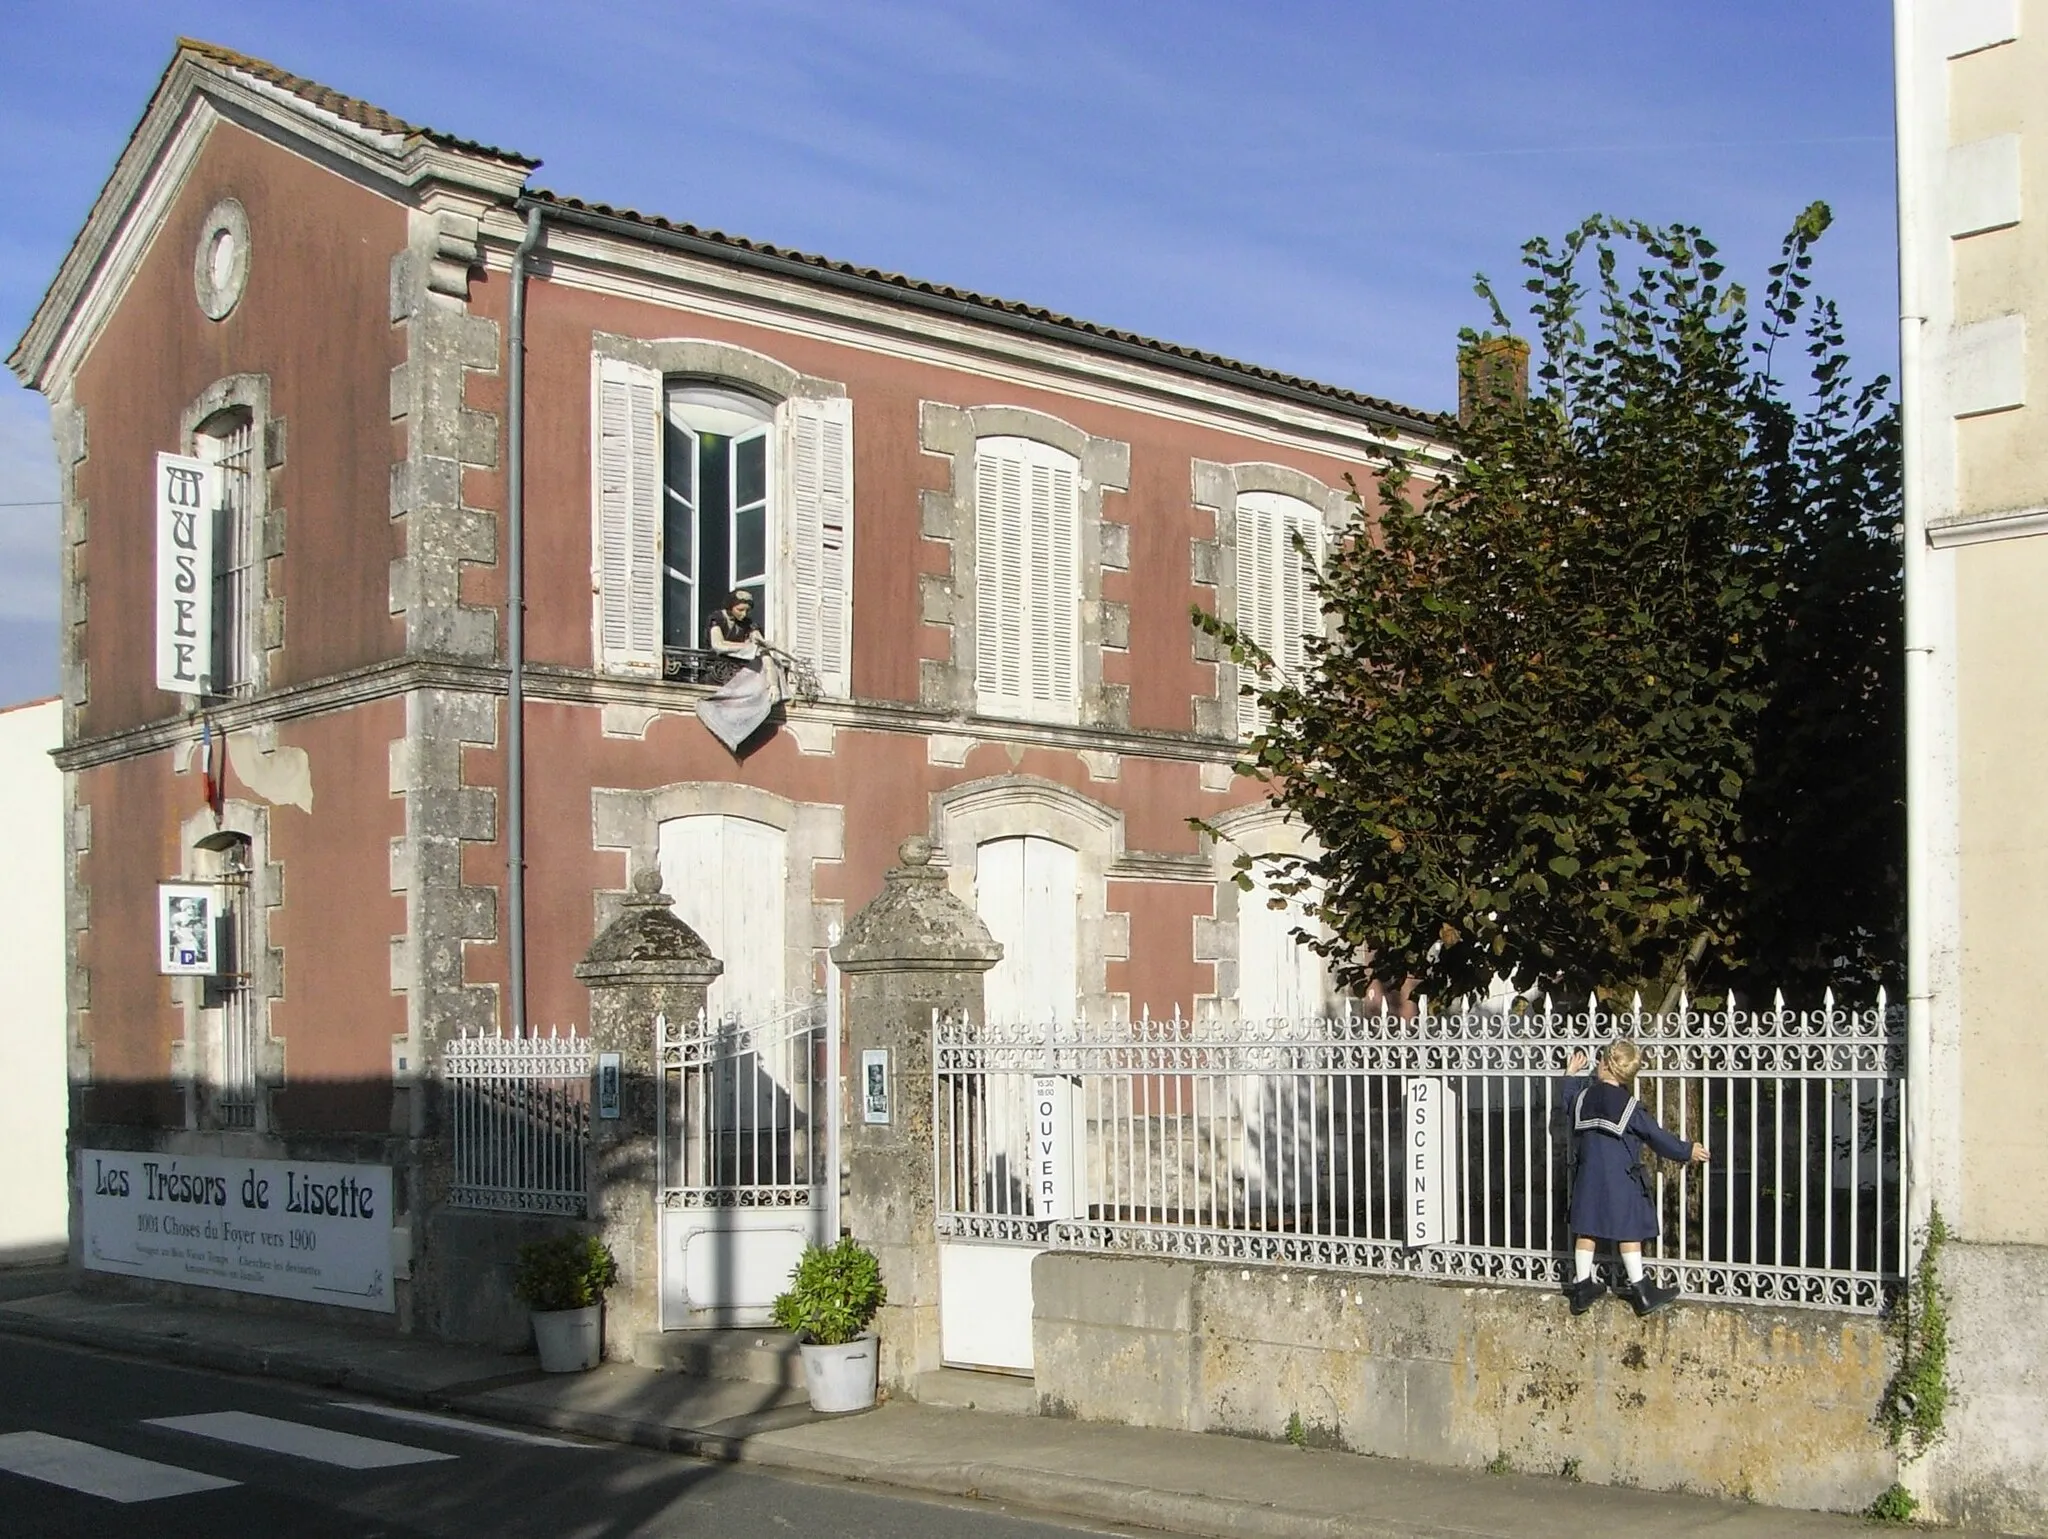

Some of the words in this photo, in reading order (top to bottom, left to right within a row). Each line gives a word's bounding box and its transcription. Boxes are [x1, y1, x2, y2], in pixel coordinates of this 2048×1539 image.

[166, 466, 204, 681] MUSEE
[1411, 1083, 1427, 1102] 12
[96, 1159, 129, 1197] Les
[143, 1162, 226, 1206] Trésors
[242, 1168, 269, 1209] de
[286, 1171, 374, 1219] Lisette
[1040, 1101, 1053, 1214] OUVERT
[1414, 1108, 1426, 1239] SCENES
[137, 1214, 159, 1233] 1001
[163, 1215, 201, 1238] Choses
[204, 1220, 218, 1239] du
[223, 1222, 255, 1250] Foyer
[261, 1232, 284, 1247] vers
[289, 1229, 317, 1251] 1900
